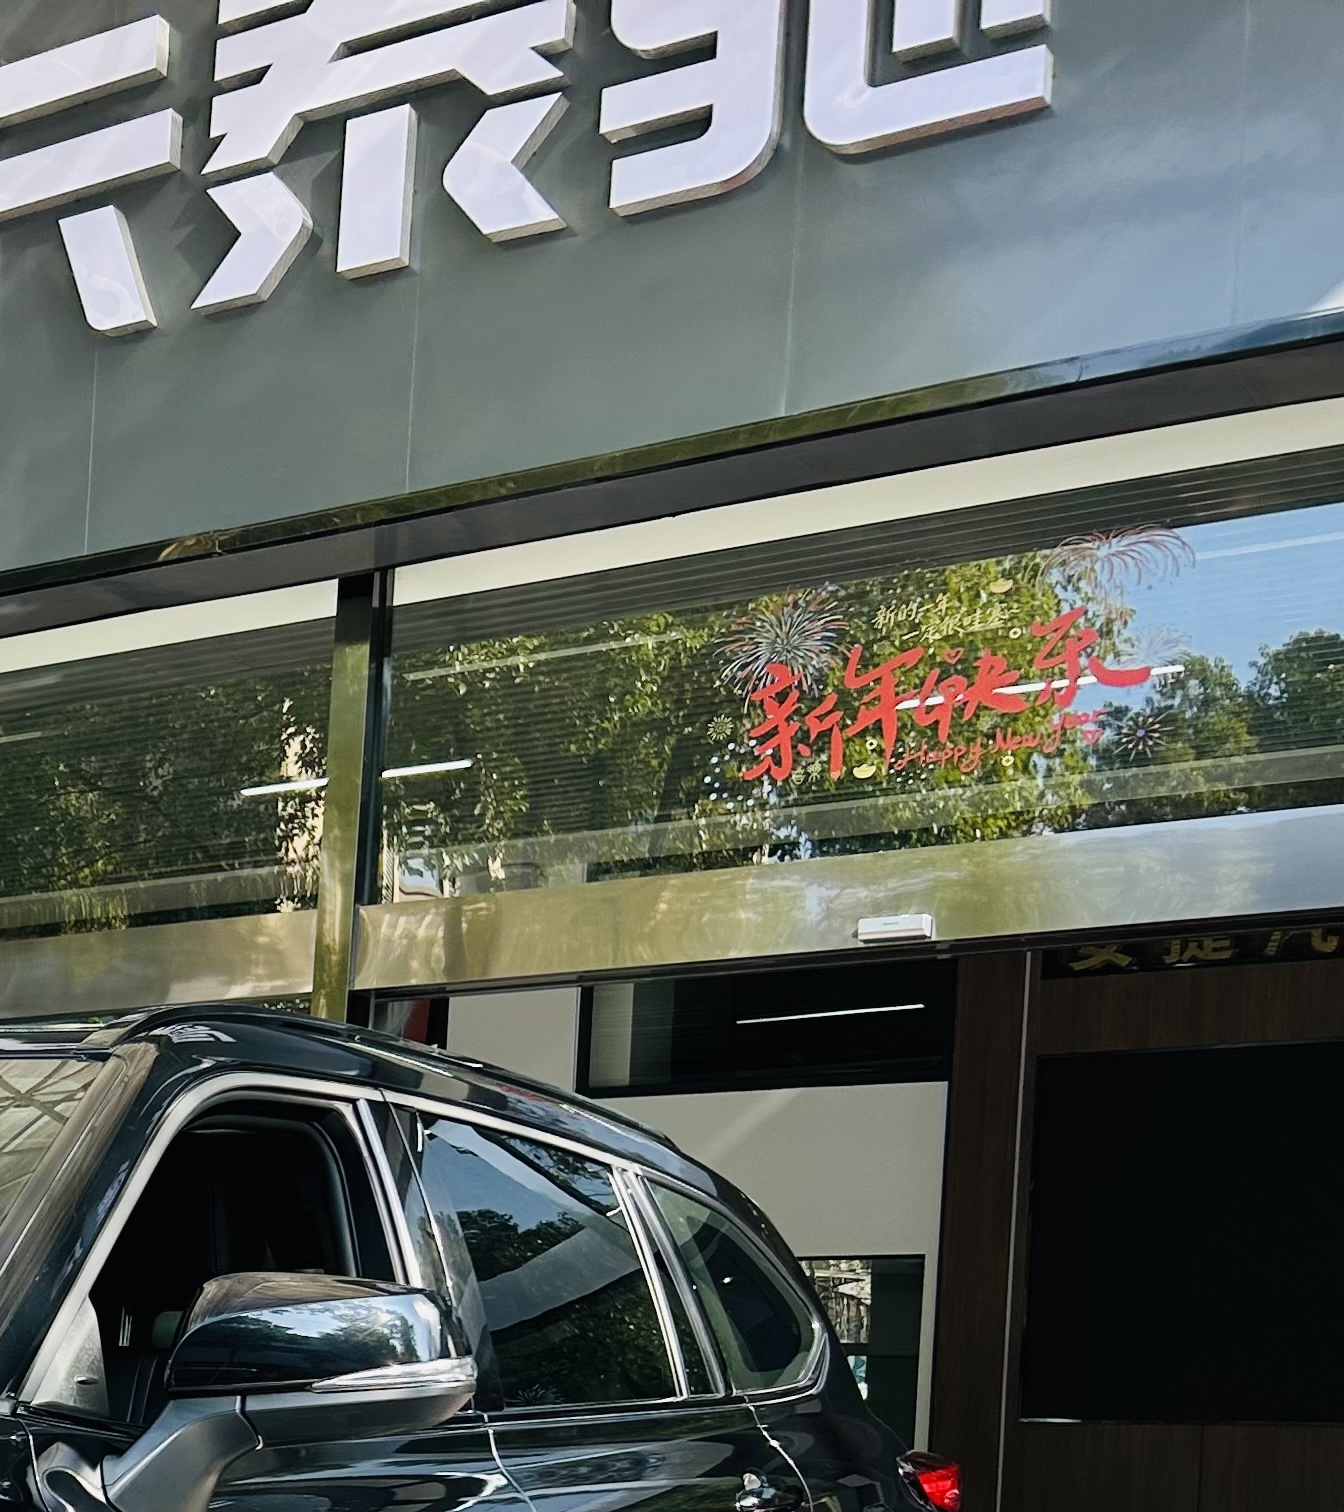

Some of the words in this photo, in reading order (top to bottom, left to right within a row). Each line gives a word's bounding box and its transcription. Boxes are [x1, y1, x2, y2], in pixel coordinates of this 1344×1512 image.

[871, 593, 952, 634] 新的一年
[743, 607, 1151, 780] 新年快乐
